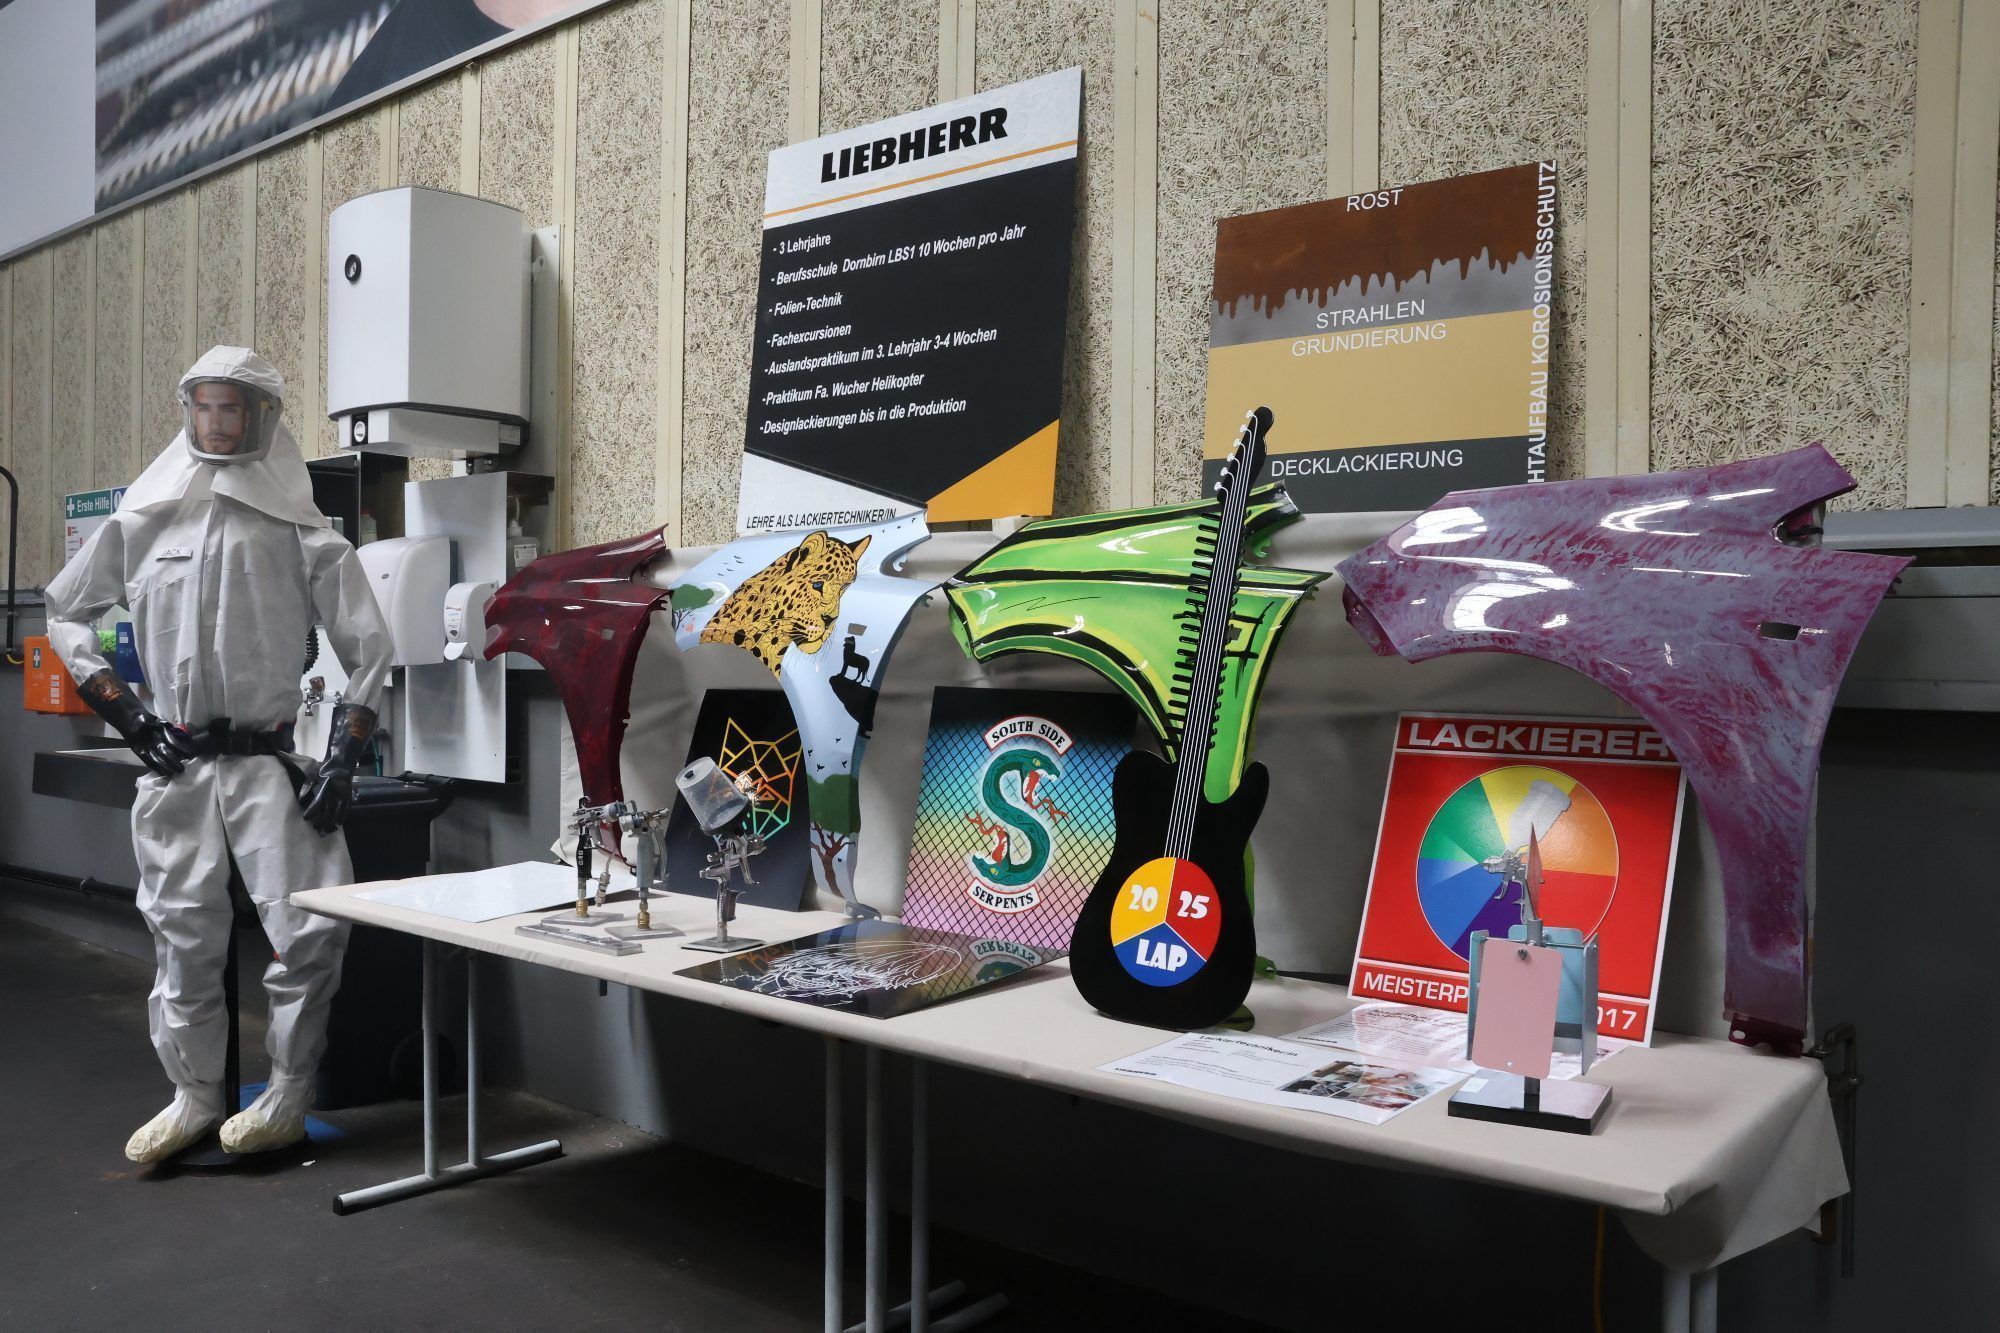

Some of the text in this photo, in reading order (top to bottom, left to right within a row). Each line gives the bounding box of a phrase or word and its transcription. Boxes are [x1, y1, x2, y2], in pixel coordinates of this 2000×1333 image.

[821, 107, 1008, 183] LIEBHERR
[1346, 188, 1403, 212] ROST
[776, 262, 838, 285] Berufsschule
[842, 254, 885, 273] Dornbirn
[888, 244, 915, 263] LBS1
[918, 242, 931, 258] 10
[932, 235, 976, 255] Wochen
[977, 231, 998, 249] pro
[999, 223, 1026, 241] Jahr
[779, 241, 785, 255] 3
[787, 232, 831, 254] Lehrjahre
[774, 292, 843, 316] Folien-Technik
[1316, 299, 1425, 329] STRAHLEN
[1527, 160, 1557, 483] HTAUFBAU KOROSIONSSCHUTZ
[861, 347, 874, 361] im
[877, 345, 885, 359] 3.
[887, 338, 932, 358] Lehrjahr
[934, 335, 950, 350] 3-4
[953, 327, 997, 347] Wochen
[1291, 323, 1447, 357] GRUNDIERUNG
[815, 384, 829, 399] Fa.
[832, 378, 870, 397] Wucher
[871, 371, 925, 392] Helikopter
[859, 408, 874, 424] bis
[877, 405, 887, 421] in
[889, 404, 905, 420] die
[907, 397, 966, 417] Produktion
[1271, 449, 1464, 477] DECKLACKIERUNG
[77, 497, 110, 513] Erste Hilfe
[746, 508, 897, 529] LEHRE ALS LACKIERTECHNIKER/IN
[991, 720, 1067, 749] SOUTH SIDE
[1408, 722, 1669, 758] LACKIERER
[973, 886, 1034, 909] SERPENTS
[1129, 884, 1210, 919] 20 25
[1135, 938, 1188, 972] LAP
[1363, 971, 1637, 1030] MEISTERP 017
